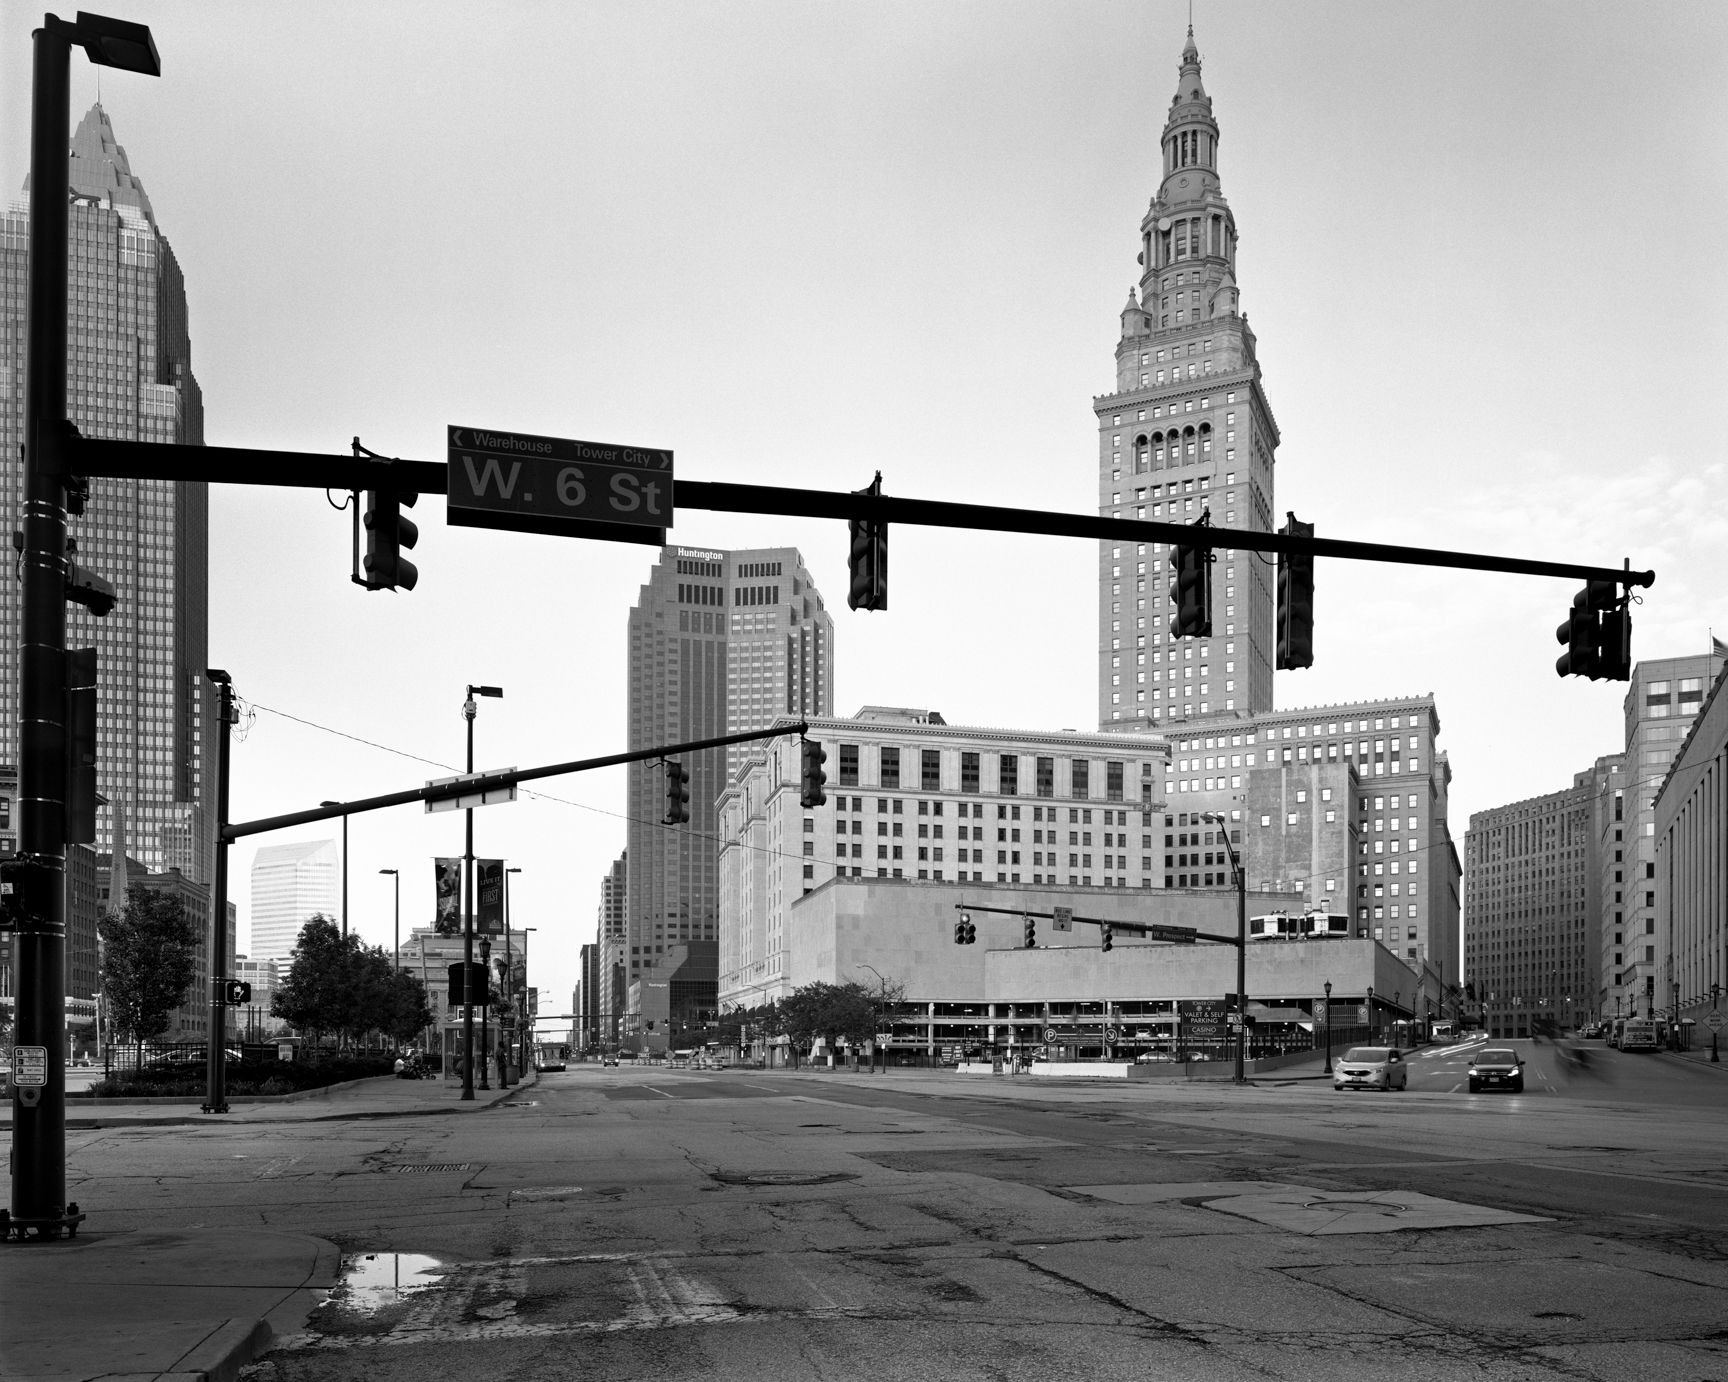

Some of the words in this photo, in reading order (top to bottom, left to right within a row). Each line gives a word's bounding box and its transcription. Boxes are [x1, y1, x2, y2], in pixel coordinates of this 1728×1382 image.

[473, 431, 553, 453] Warehouse
[574, 443, 617, 461] Tower
[623, 448, 651, 467] City
[462, 455, 533, 502] W.
[556, 466, 587, 506] 6
[608, 472, 661, 515] St
[678, 547, 723, 561] Huntington
[482, 889, 499, 904] FIRST
[1163, 932, 1185, 940] Prospect
[1047, 1031, 1054, 1040] P
